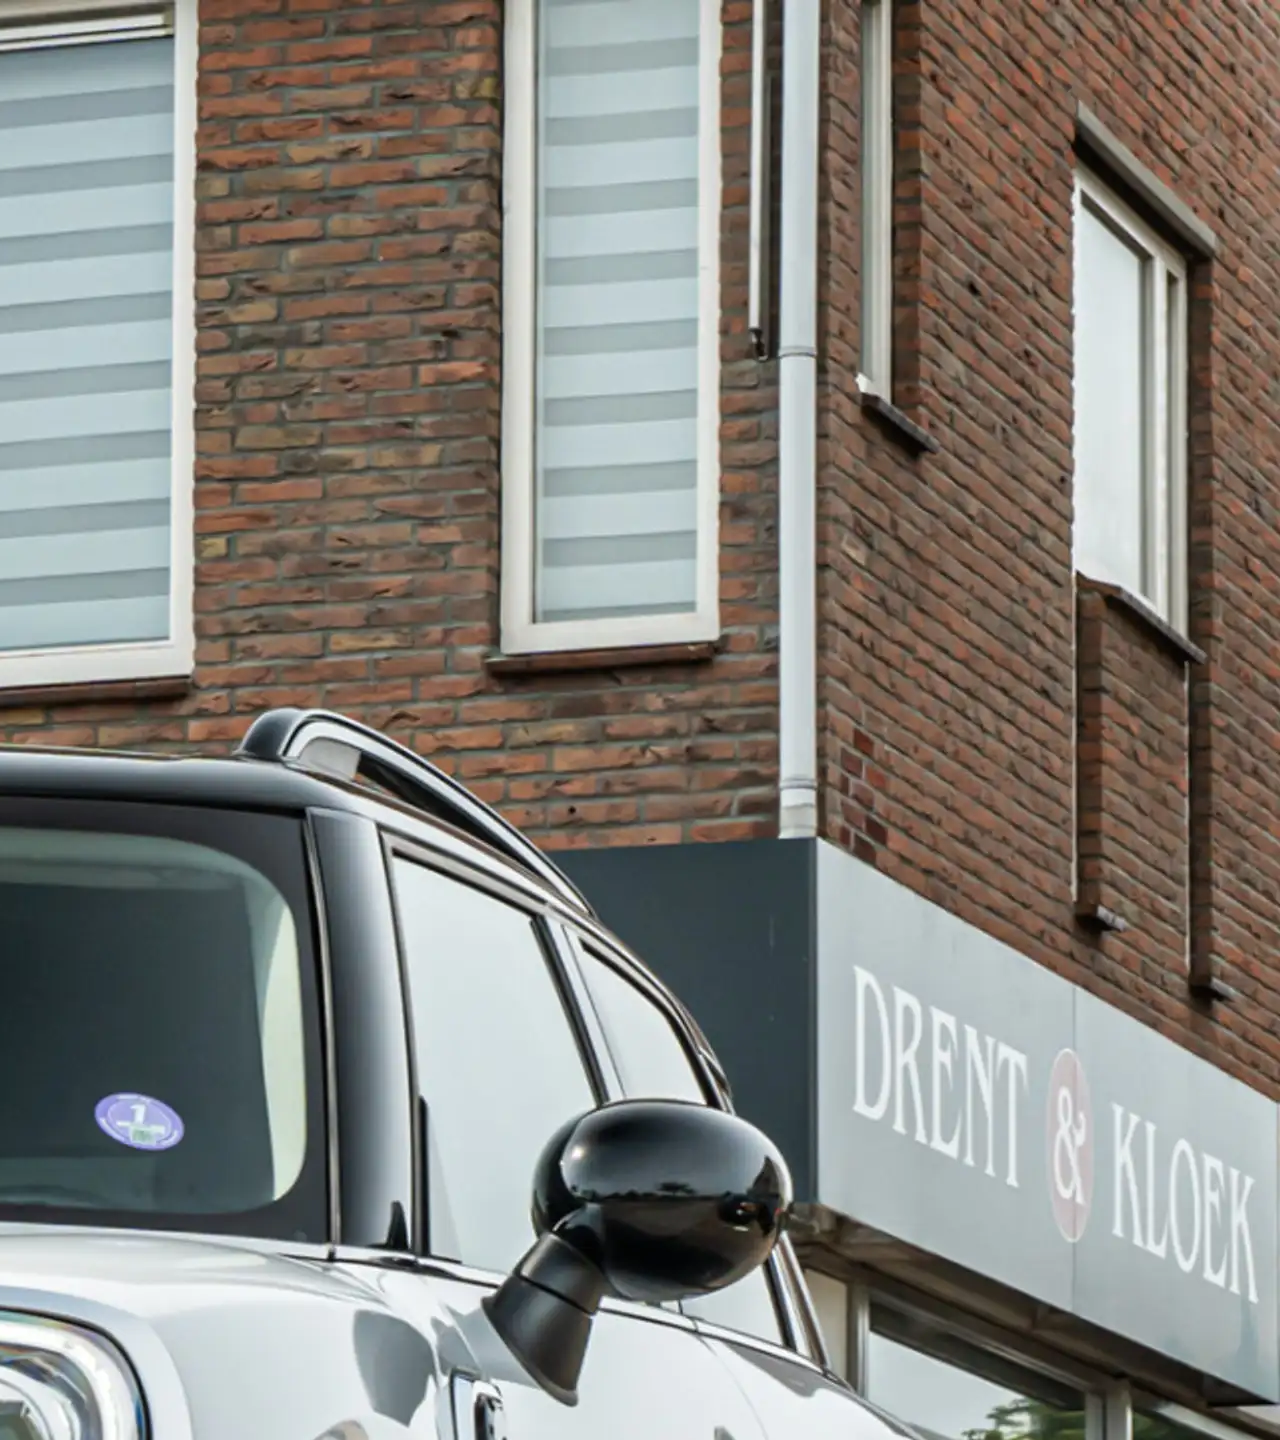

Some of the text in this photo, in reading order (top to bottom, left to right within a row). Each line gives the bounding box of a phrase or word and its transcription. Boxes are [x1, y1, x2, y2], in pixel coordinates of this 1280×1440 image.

[852, 964, 1260, 1304] DRENT & KLOEK
